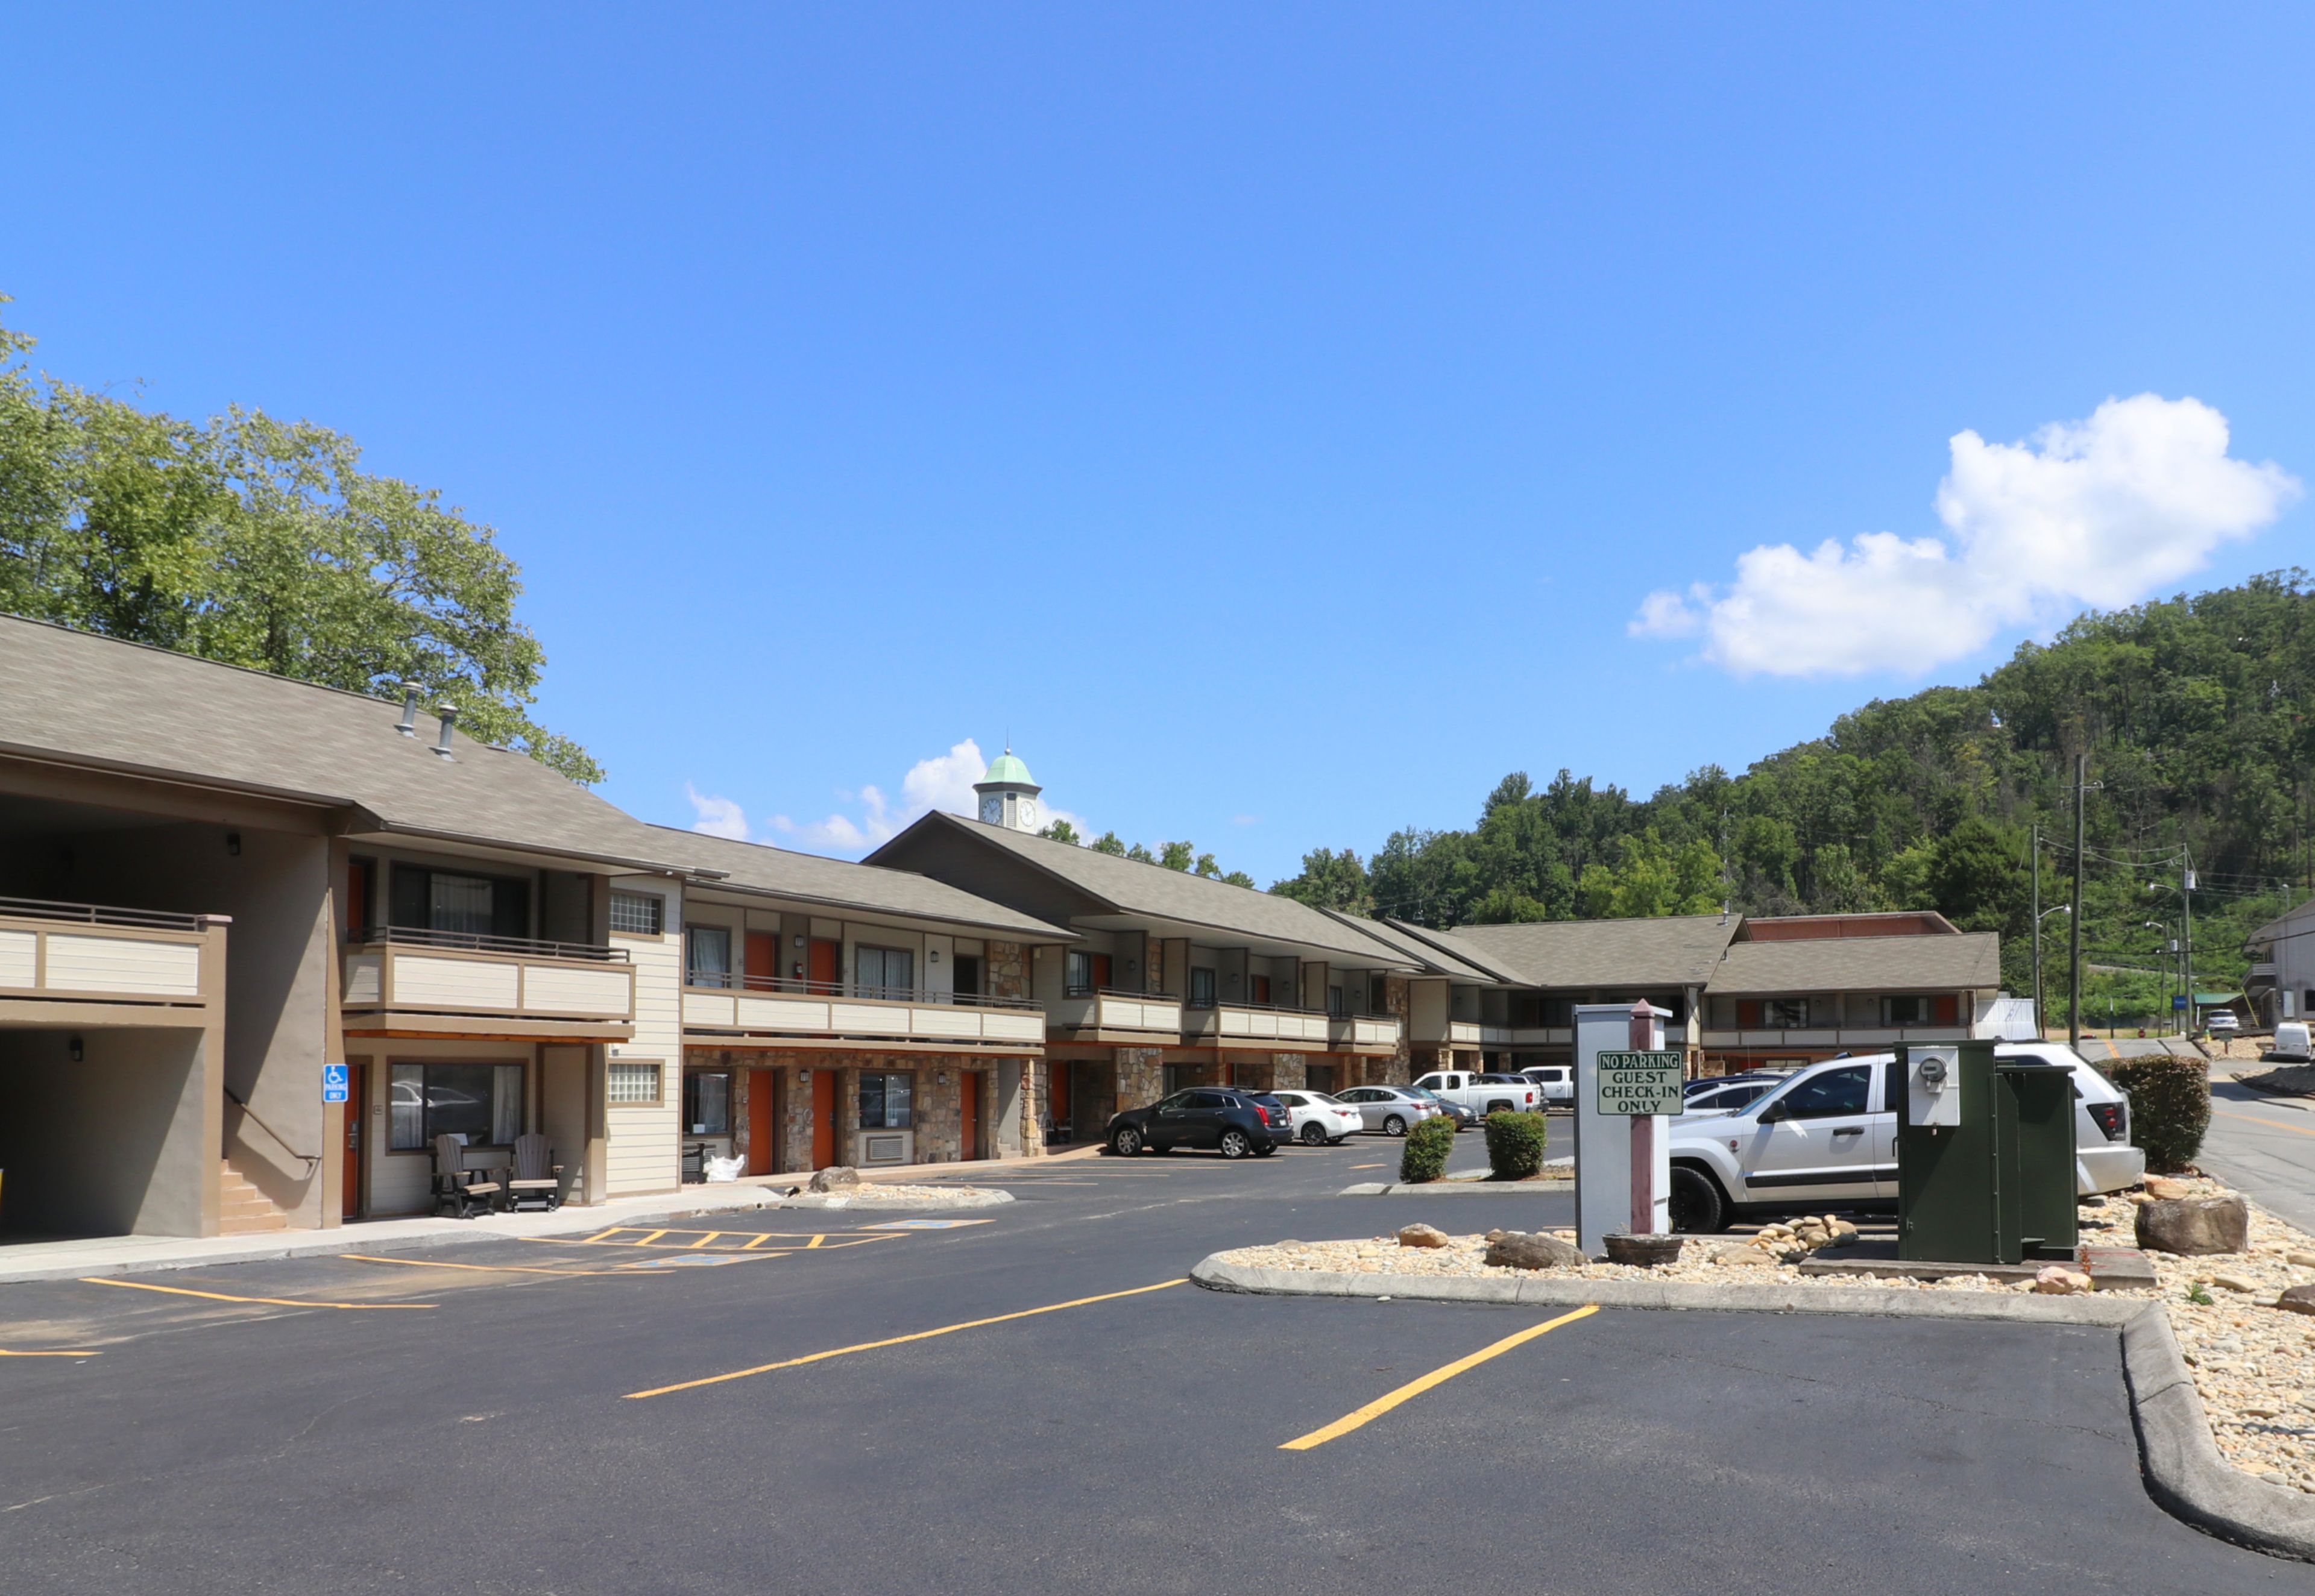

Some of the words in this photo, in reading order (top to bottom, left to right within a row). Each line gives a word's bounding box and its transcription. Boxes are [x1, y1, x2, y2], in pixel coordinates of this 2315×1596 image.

[1602, 1055, 1619, 1069] NO
[1622, 1055, 1678, 1068] PARKING
[1612, 1072, 1668, 1084] GUEST
[1602, 1086, 1679, 1098] CHECK-IN
[1617, 1101, 1661, 1113] ONLY
